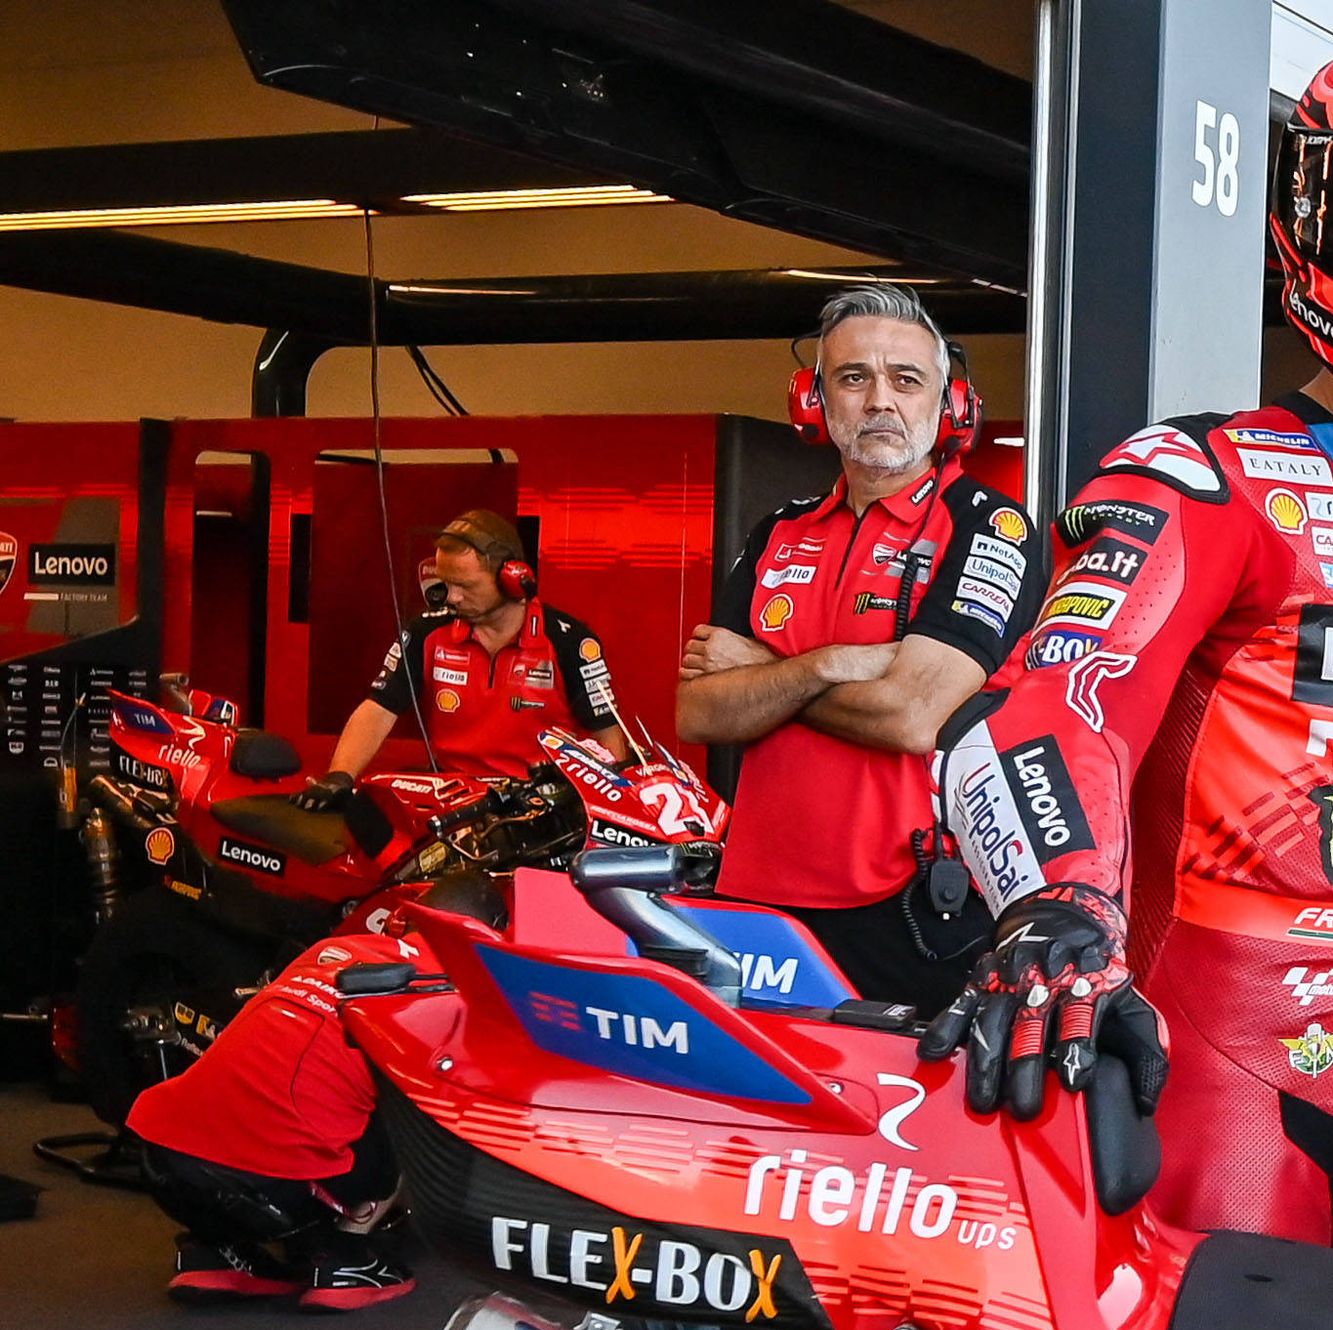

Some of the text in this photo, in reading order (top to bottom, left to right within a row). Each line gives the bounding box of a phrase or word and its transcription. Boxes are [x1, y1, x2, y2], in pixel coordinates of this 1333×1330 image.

[1191, 99, 1240, 217] 58
[1254, 431, 1311, 447] MICHELIN
[1250, 457, 1323, 477] EATALY
[910, 479, 935, 504] Lenovo
[1084, 503, 1156, 527] MONSTER
[34, 550, 109, 577] Lenovo
[134, 712, 157, 729] TIM
[158, 743, 203, 768] riello
[390, 778, 434, 794] DUCATI
[566, 765, 624, 804] riello
[1013, 745, 1072, 848] Lenovo
[591, 820, 660, 849] Lenov
[961, 761, 1030, 903] UnipolSai
[220, 840, 282, 872] Lenovo
[307, 992, 338, 1013] Spor
[585, 1004, 690, 1056] TIM
[742, 1148, 959, 1241] riello
[957, 1221, 1017, 1251] ups
[491, 1215, 784, 1324] FLEX-BOX
